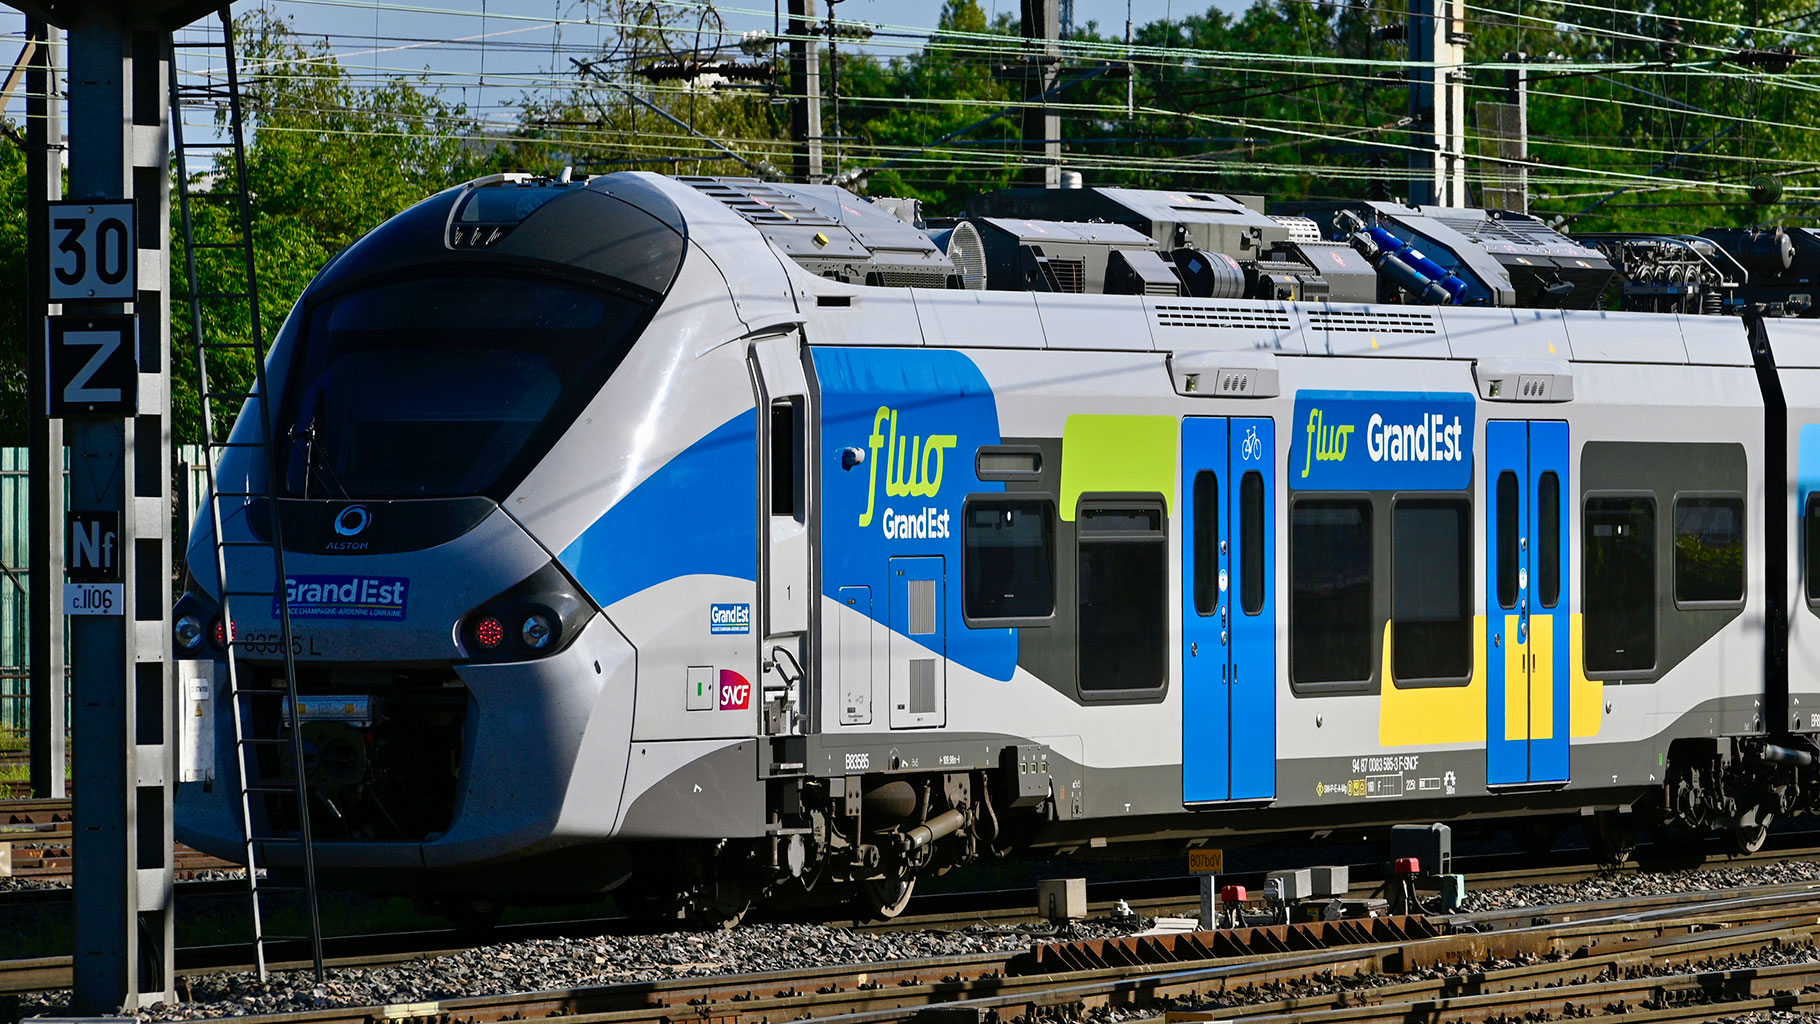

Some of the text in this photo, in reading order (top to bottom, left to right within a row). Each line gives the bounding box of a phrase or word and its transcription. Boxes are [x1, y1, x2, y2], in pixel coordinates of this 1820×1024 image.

[54, 217, 128, 285] 30
[63, 331, 121, 402] Z
[1302, 408, 1354, 478] fluo
[859, 406, 957, 527] fluo
[73, 521, 115, 568] Nf
[326, 542, 369, 550] ALSTOM
[787, 585, 791, 600] 1
[299, 607, 369, 616] CHAMPAGNE-ARDENNE
[370, 609, 402, 618] LORRAINE
[310, 636, 322, 656] L
[721, 685, 749, 705] SNCF
[1352, 758, 1360, 773] 94
[1361, 757, 1369, 773] 87
[1399, 755, 1419, 771] F-SNCF
